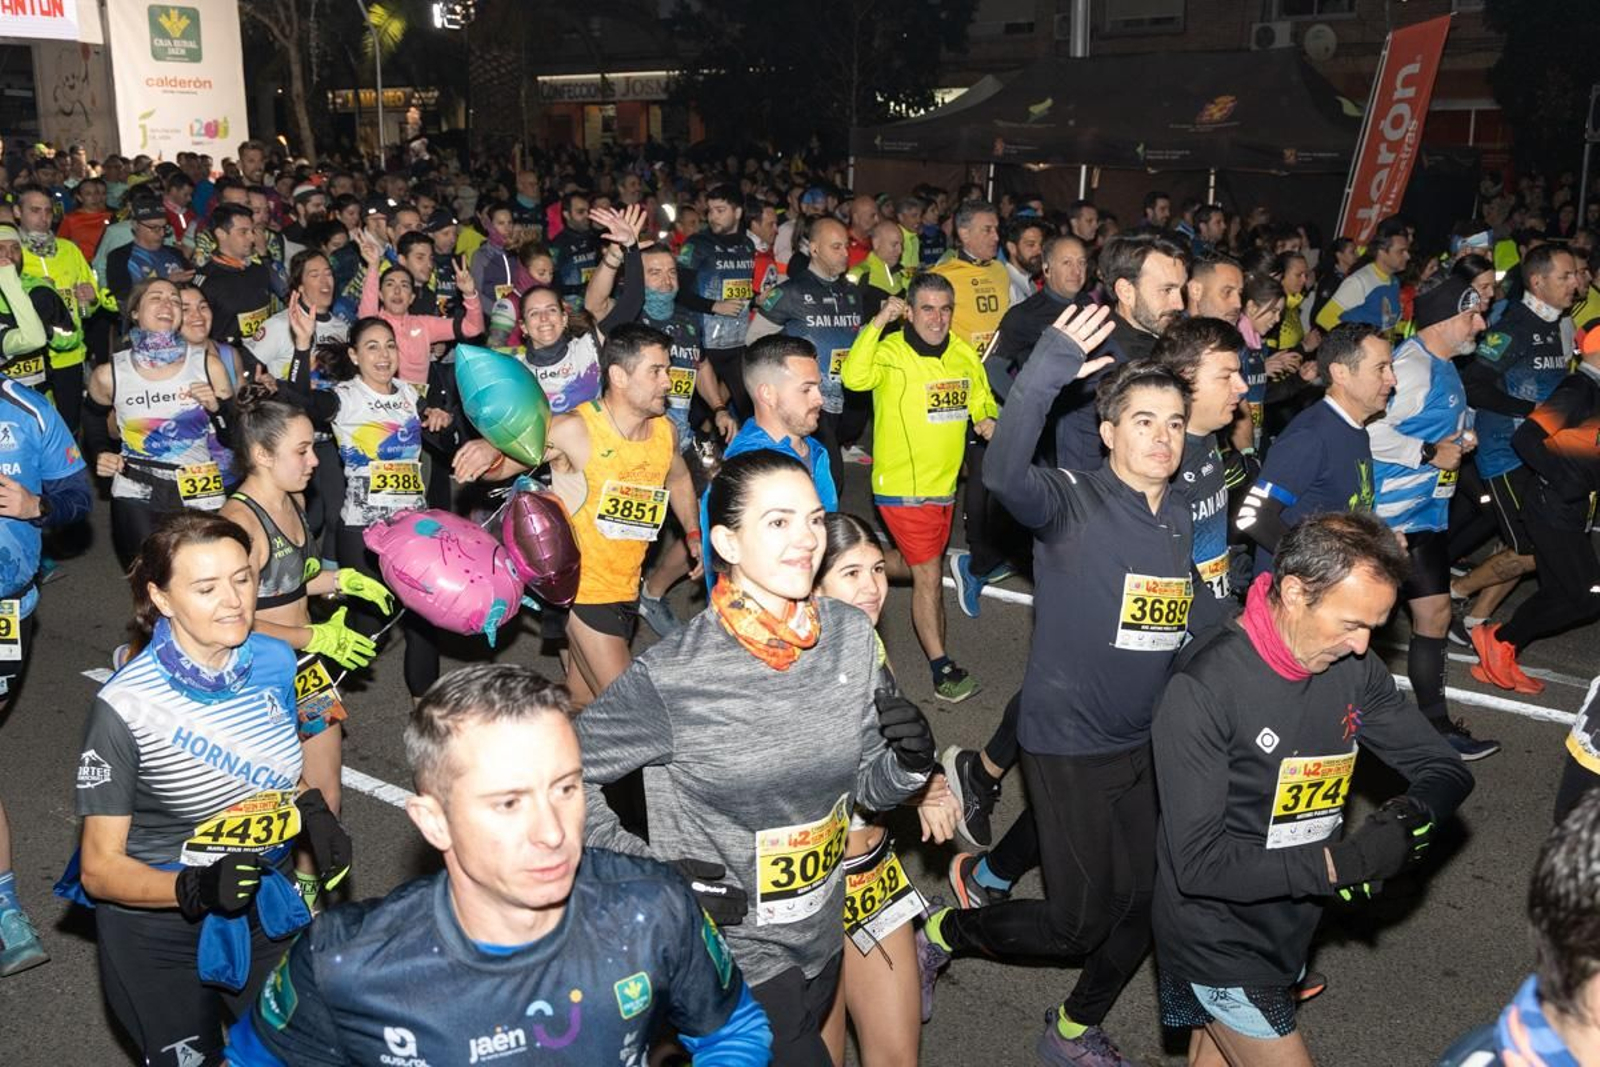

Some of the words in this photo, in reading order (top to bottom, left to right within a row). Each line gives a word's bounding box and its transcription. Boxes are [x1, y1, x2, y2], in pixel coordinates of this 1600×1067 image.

[976, 295, 999, 313] GO
[805, 314, 832, 327] SAN
[671, 380, 692, 395] 62
[931, 391, 967, 408] 3489
[0, 463, 22, 476] RA
[185, 475, 222, 494] 325
[604, 497, 658, 522] 3851
[1130, 597, 1189, 624] 3689
[296, 668, 323, 697] 23
[171, 726, 296, 790] HORNACH
[1303, 762, 1322, 777] 42
[1282, 777, 1353, 812] 374
[199, 811, 291, 845] 4437
[788, 830, 811, 847] 42
[848, 873, 866, 888] 42
